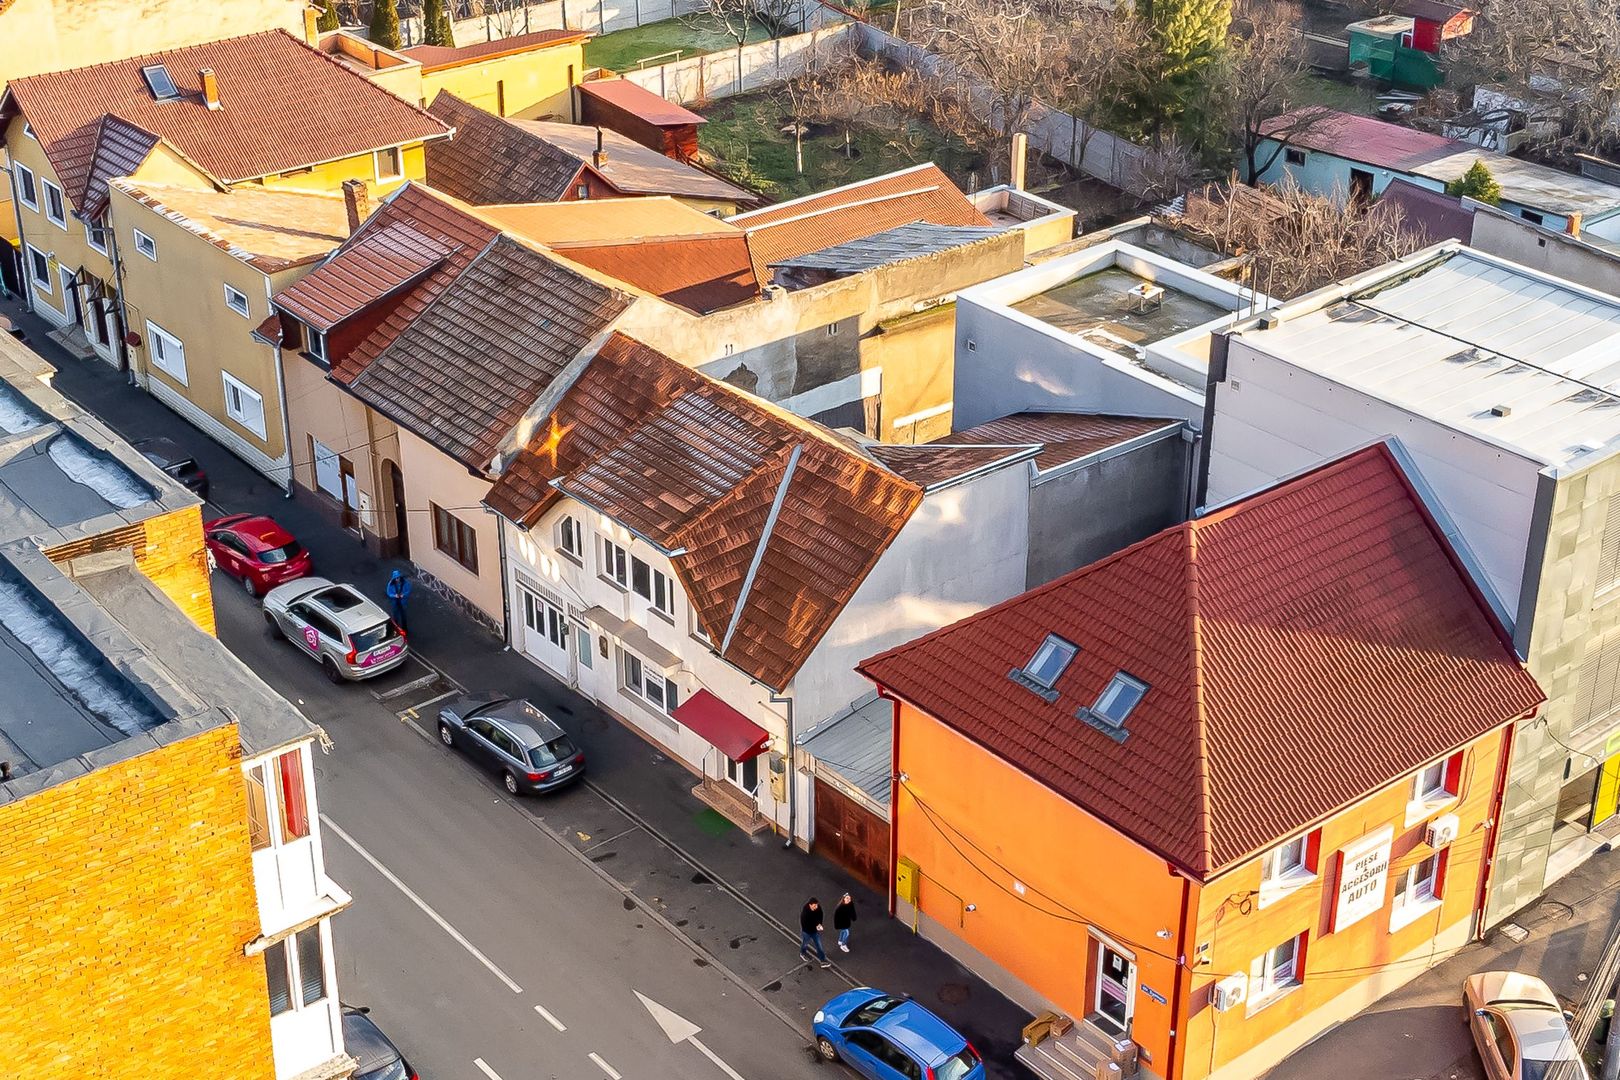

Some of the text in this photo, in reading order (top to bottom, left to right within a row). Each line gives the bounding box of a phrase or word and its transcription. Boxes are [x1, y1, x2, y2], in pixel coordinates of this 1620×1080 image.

[1355, 852, 1378, 871] PIESE
[1341, 861, 1387, 893] ACCESORII
[1347, 879, 1377, 904] AUTO
